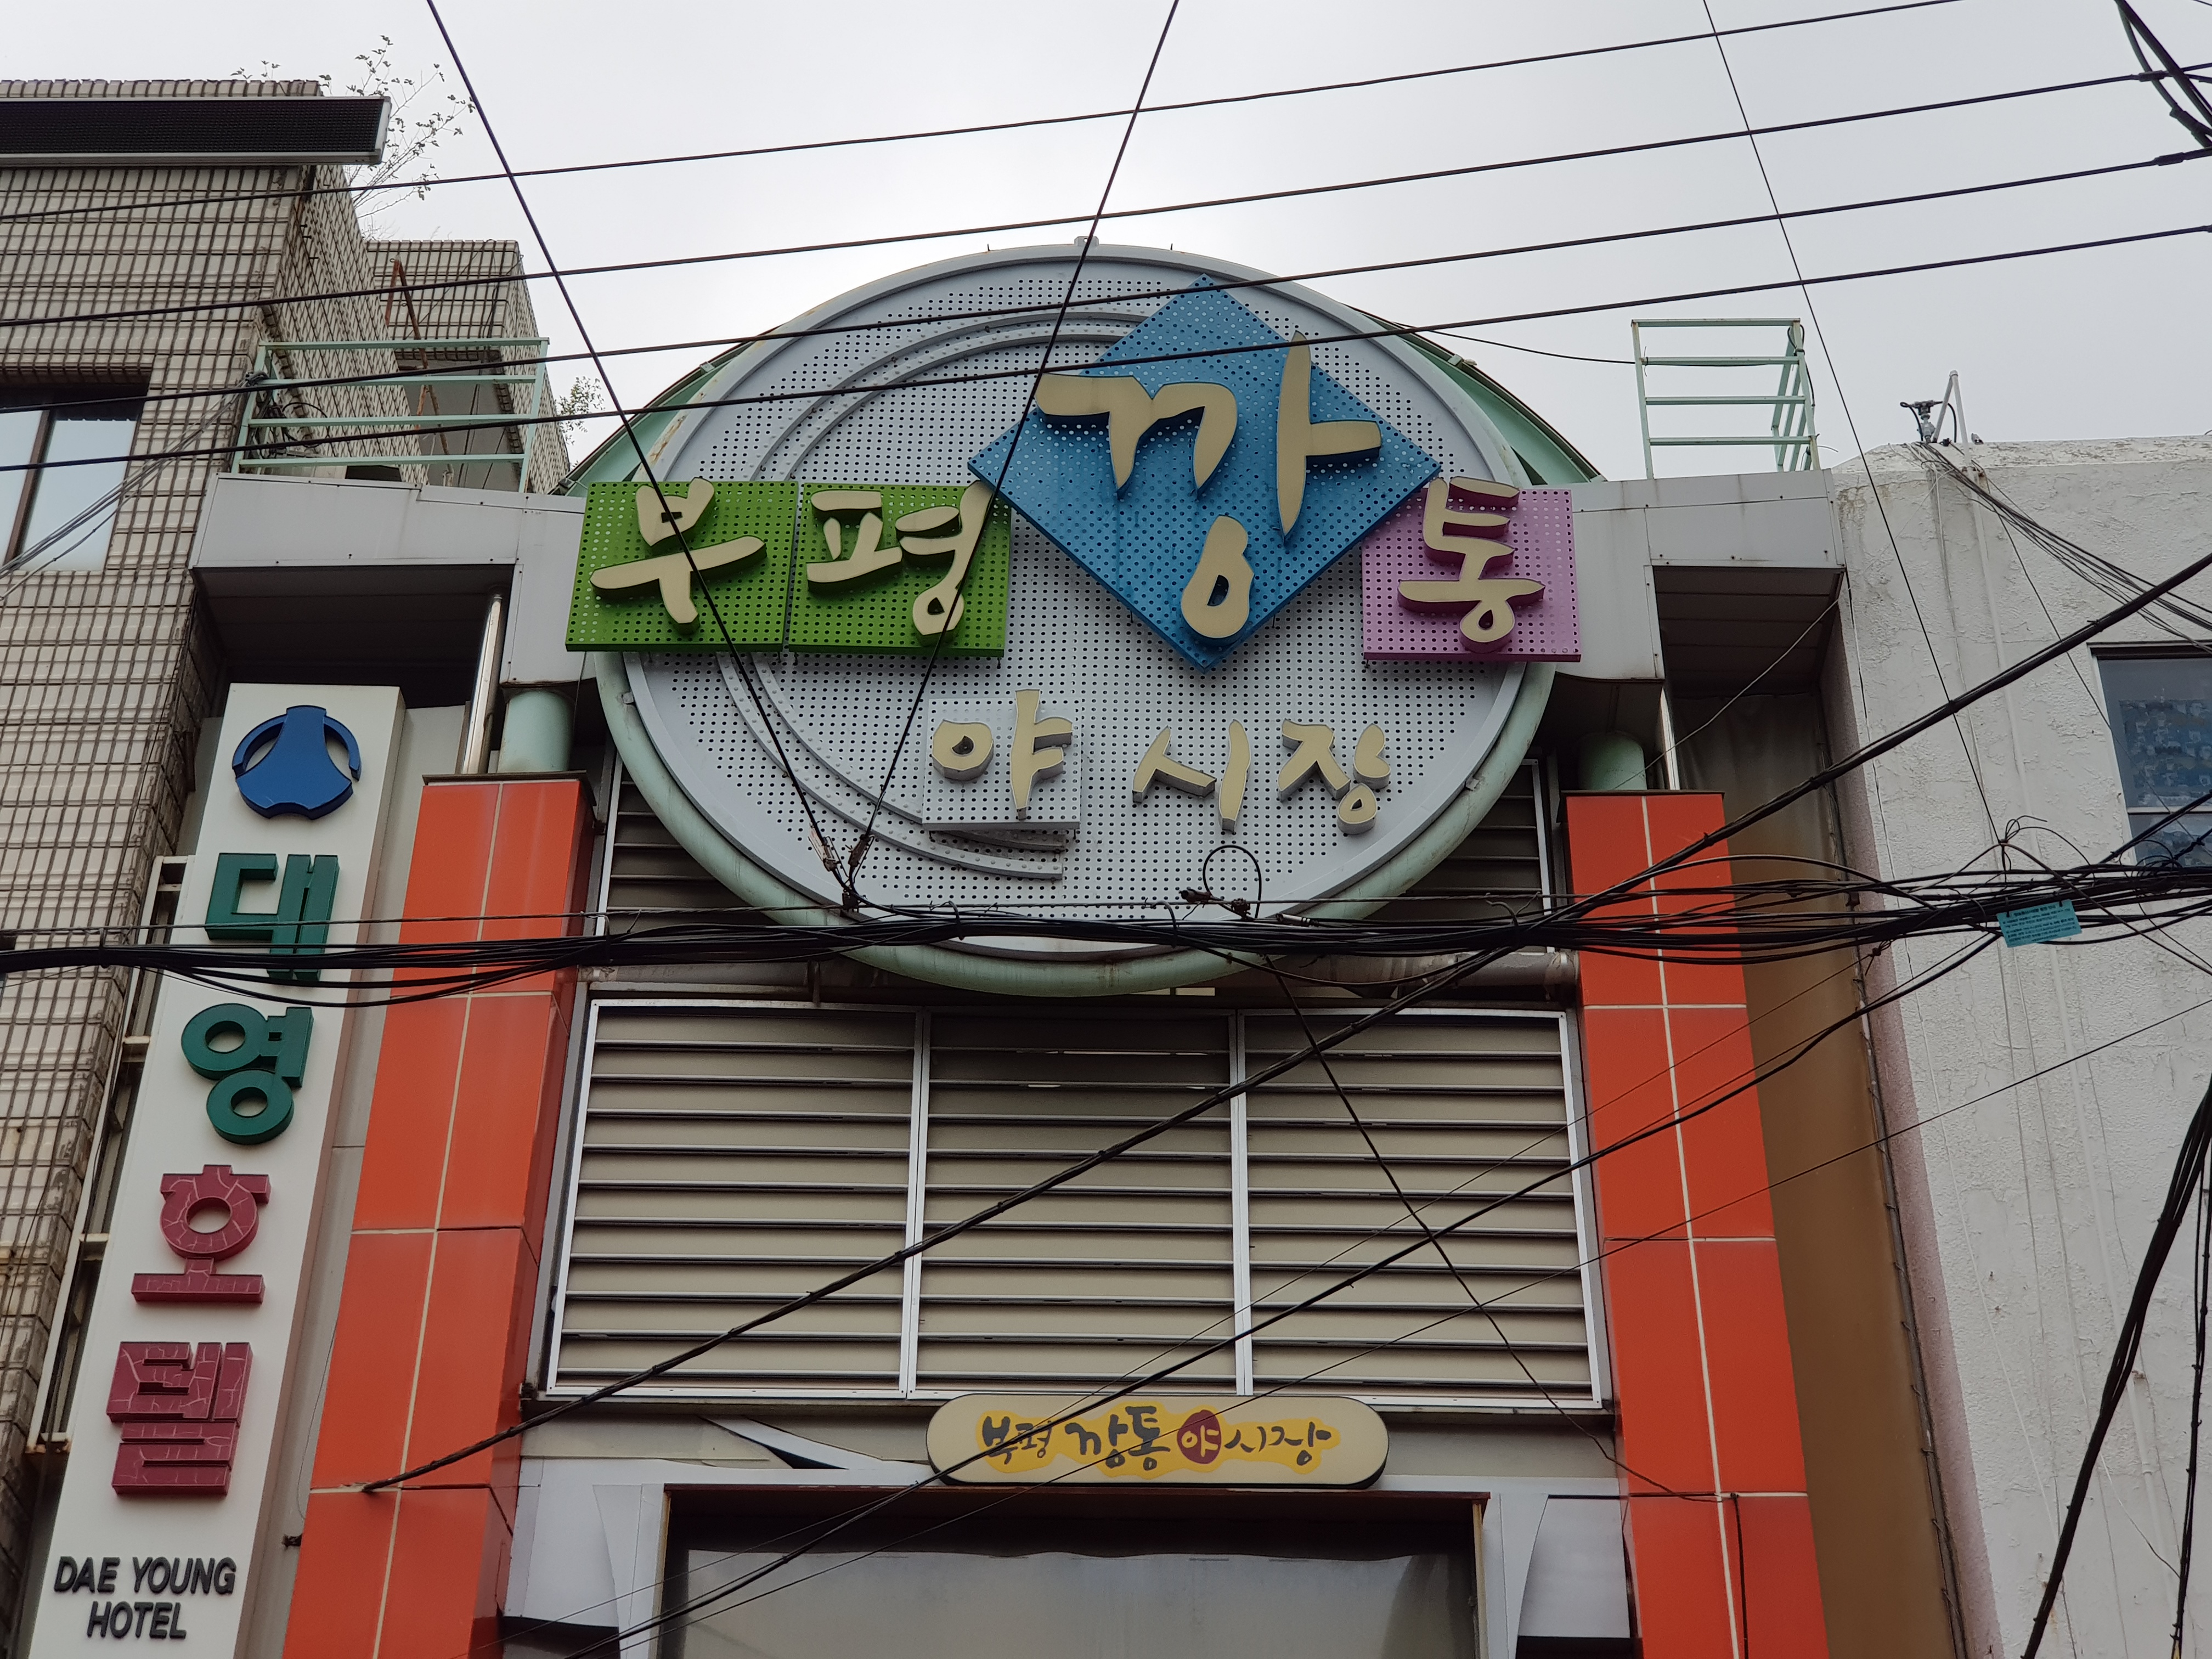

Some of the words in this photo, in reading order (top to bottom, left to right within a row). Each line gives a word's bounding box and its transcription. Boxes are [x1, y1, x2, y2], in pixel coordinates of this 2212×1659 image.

[589, 477, 994, 640] 부평
[1034, 330, 1546, 652] 깡통
[53, 1556, 121, 1594] DAE
[132, 1556, 237, 1595] YOUNG
[86, 1600, 187, 1639] HOTEL
